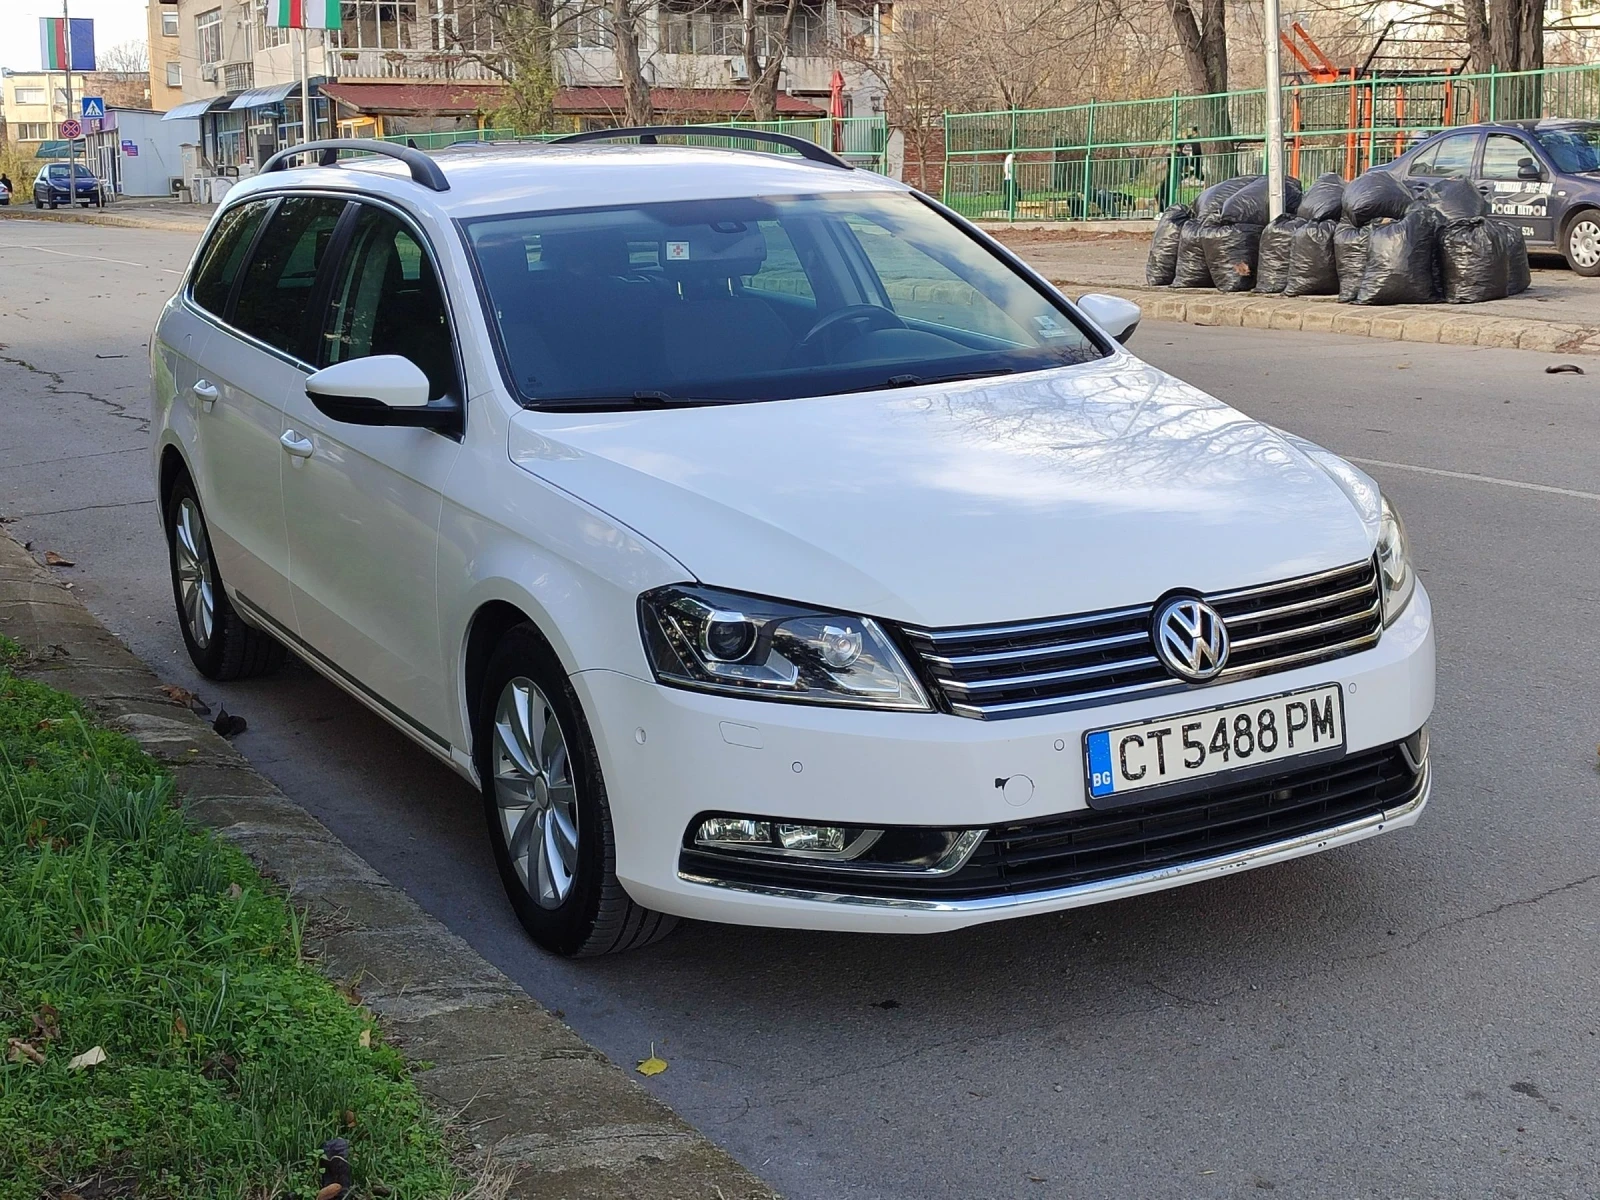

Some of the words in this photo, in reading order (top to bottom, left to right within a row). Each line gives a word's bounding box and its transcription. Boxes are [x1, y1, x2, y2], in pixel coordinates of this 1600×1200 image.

[1517, 204, 1547, 217] ПЕТРОВ
[1119, 728, 1172, 782] CT
[1181, 708, 1279, 769] 5488
[1285, 695, 1336, 748] PM
[1092, 770, 1111, 787] BG
